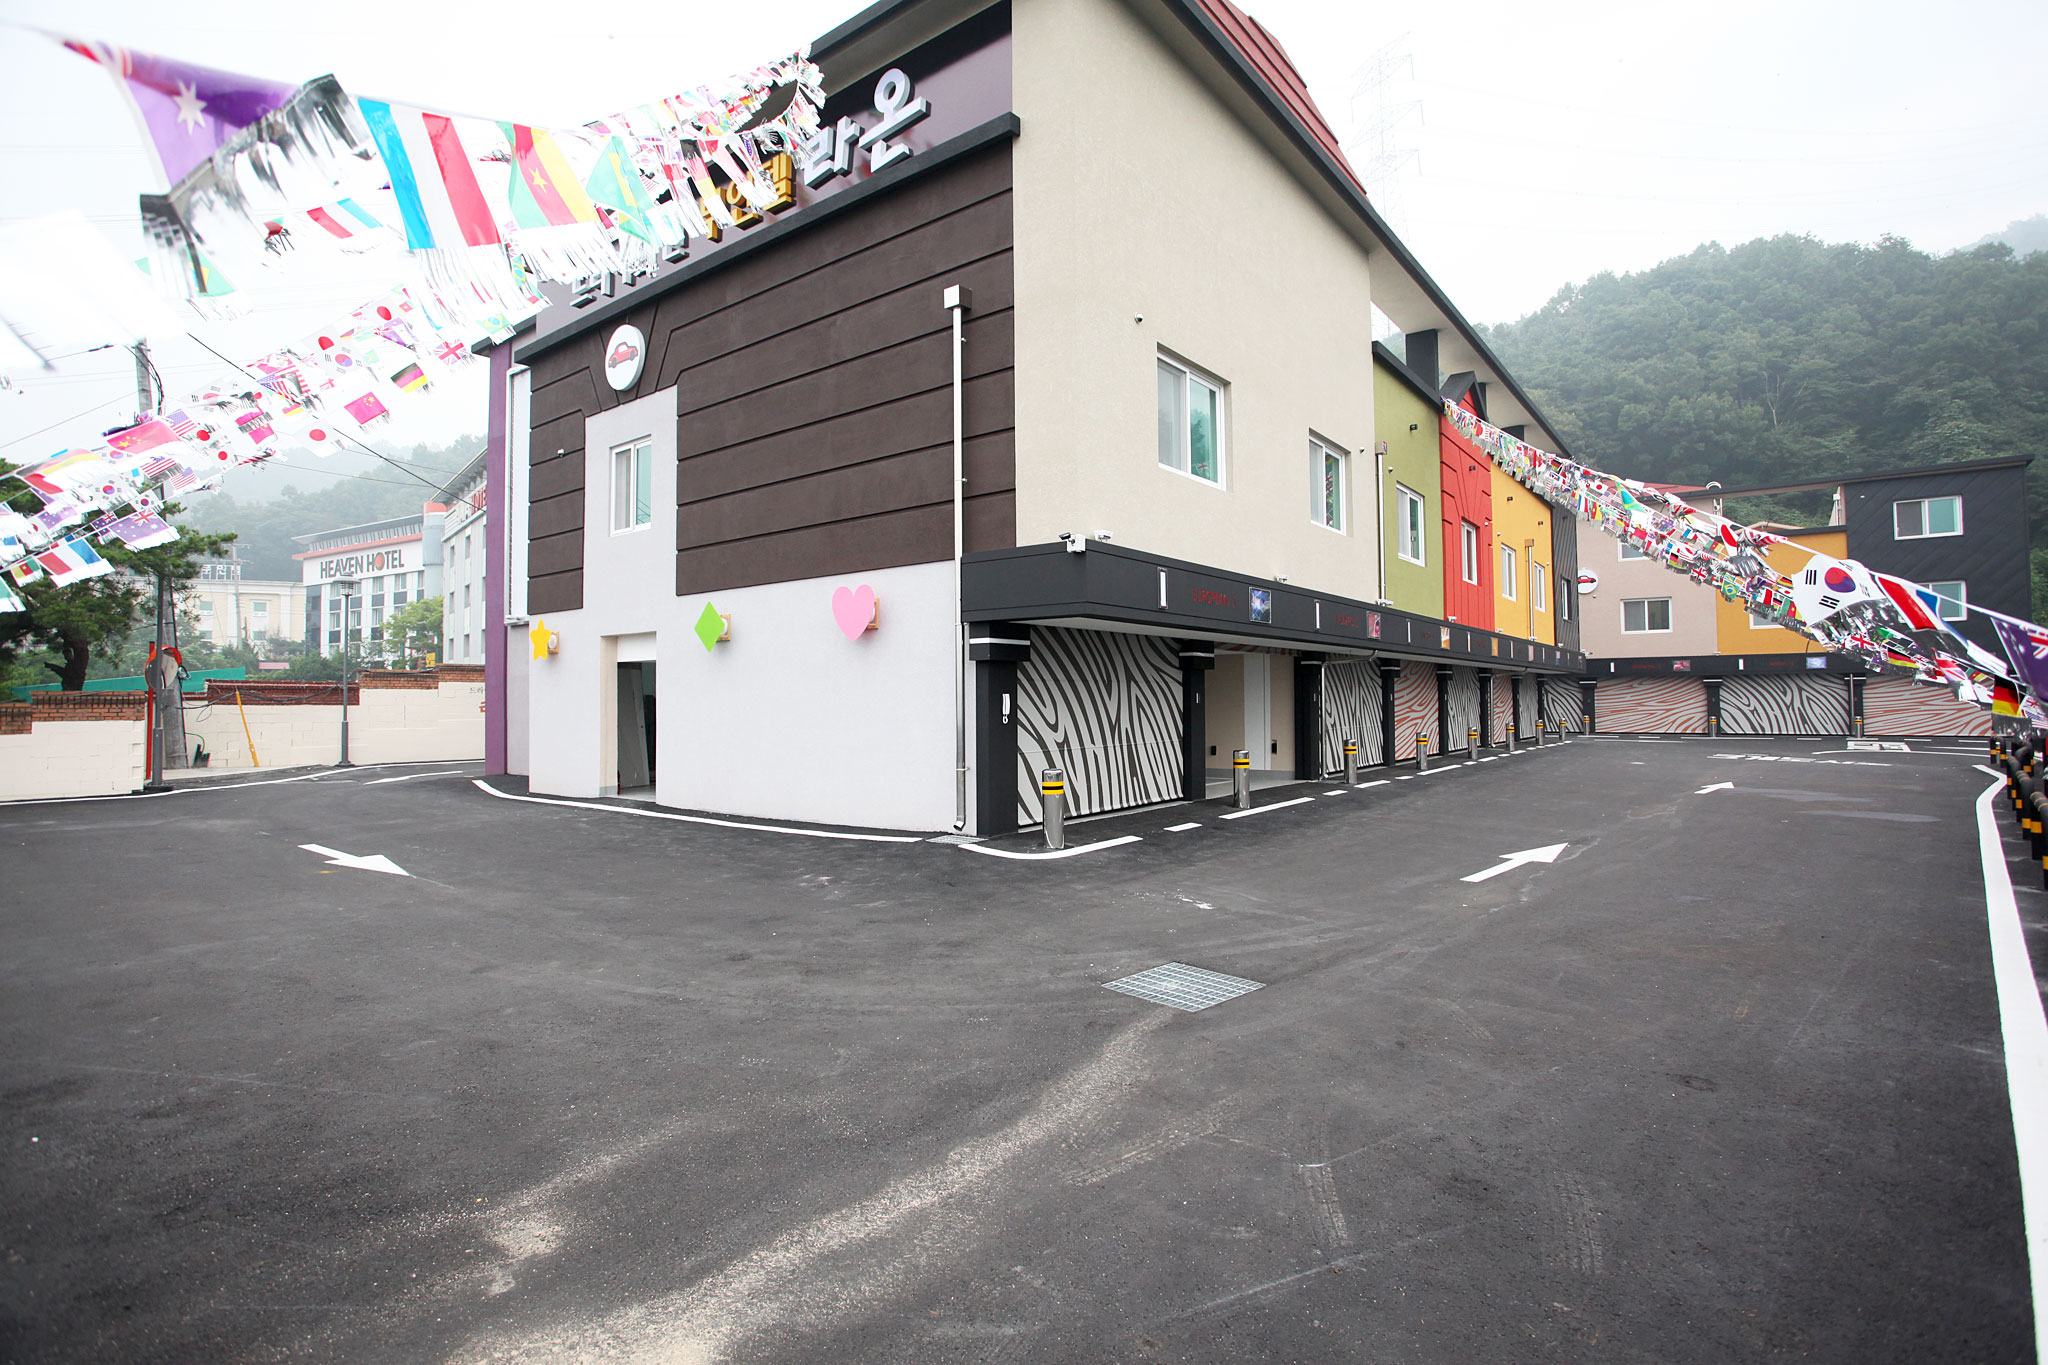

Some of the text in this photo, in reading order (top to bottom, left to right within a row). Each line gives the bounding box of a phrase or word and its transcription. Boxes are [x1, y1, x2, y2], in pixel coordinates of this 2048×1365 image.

[803, 68, 931, 190] 라온
[320, 549, 404, 579] HEAVEN HOTEL
